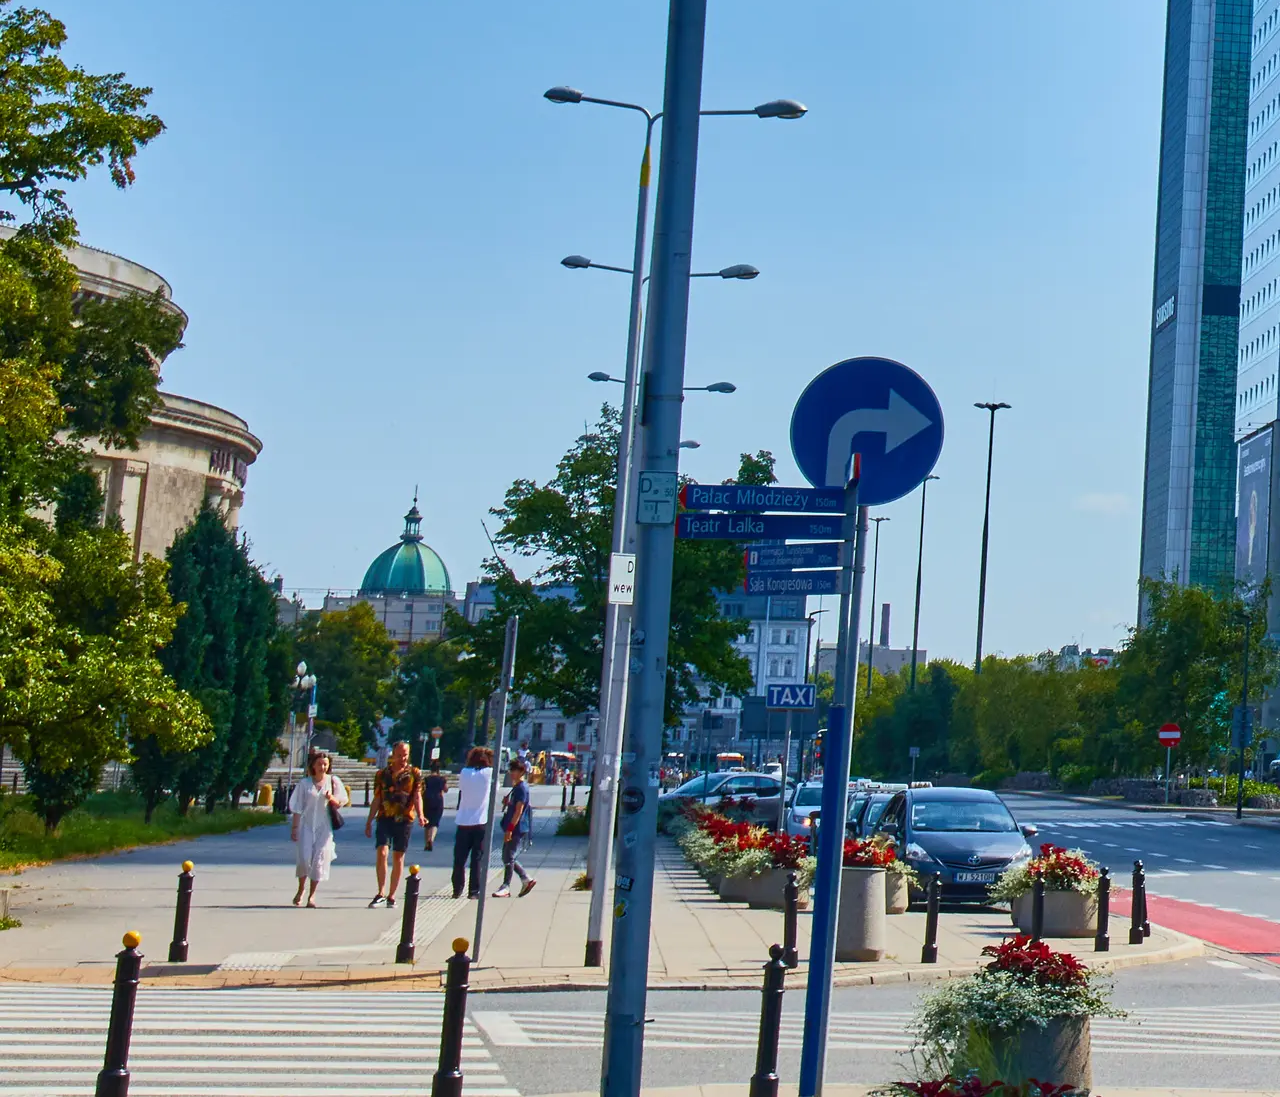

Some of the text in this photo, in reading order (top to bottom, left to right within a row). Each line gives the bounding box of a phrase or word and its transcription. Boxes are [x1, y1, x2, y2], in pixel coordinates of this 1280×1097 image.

[692, 488, 837, 511] Pałac Młodzieży 150m
[684, 517, 832, 535] Teatr Lalka 150m
[767, 578, 813, 594] Kongresowa
[769, 687, 814, 706] TAXI
